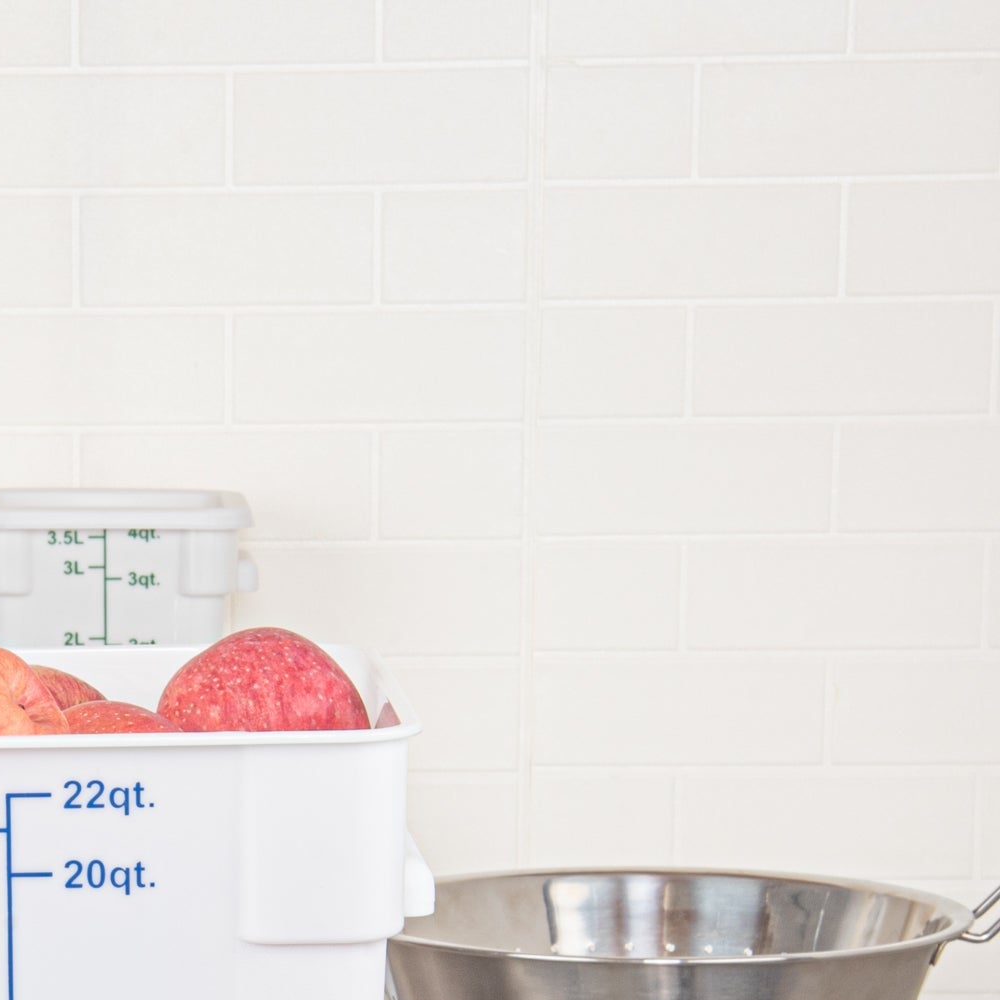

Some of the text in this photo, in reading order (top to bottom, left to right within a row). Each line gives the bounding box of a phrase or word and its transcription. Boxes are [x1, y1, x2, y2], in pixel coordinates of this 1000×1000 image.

[47, 530, 84, 545] 3.5L
[127, 528, 161, 543] 4qt.
[63, 560, 85, 575] 3L
[127, 571, 161, 589] 3qt.
[64, 632, 85, 646] 2L
[63, 780, 155, 816] 22qt.
[64, 859, 156, 896] 20qt.
